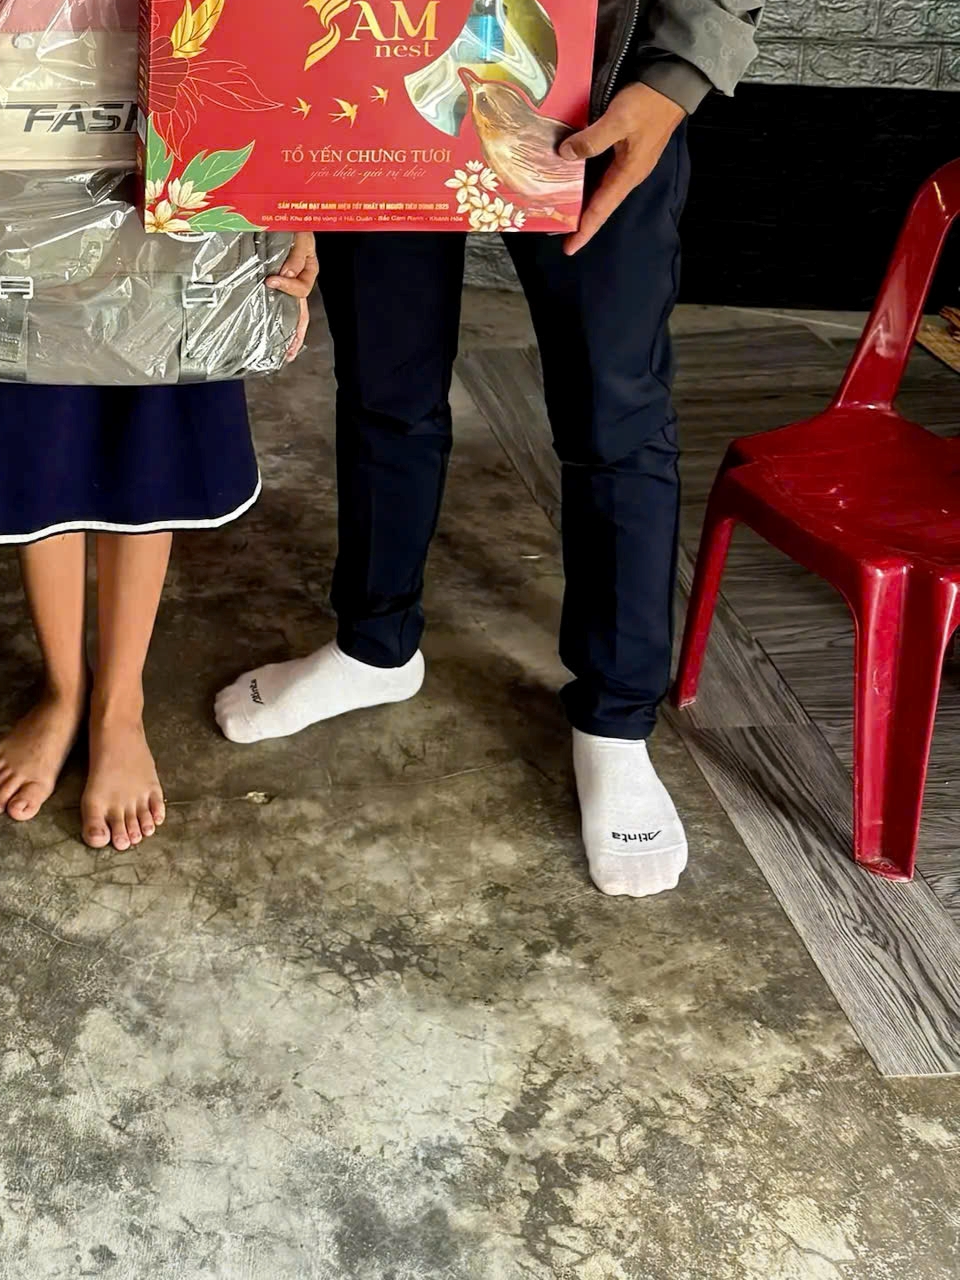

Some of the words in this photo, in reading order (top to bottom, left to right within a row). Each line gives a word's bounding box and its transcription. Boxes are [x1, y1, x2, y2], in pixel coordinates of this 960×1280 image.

[375, 41, 435, 57] nest
[281, 144, 304, 162] TỔ
[309, 145, 343, 162] YẾN
[346, 148, 407, 163] CHƯNG
